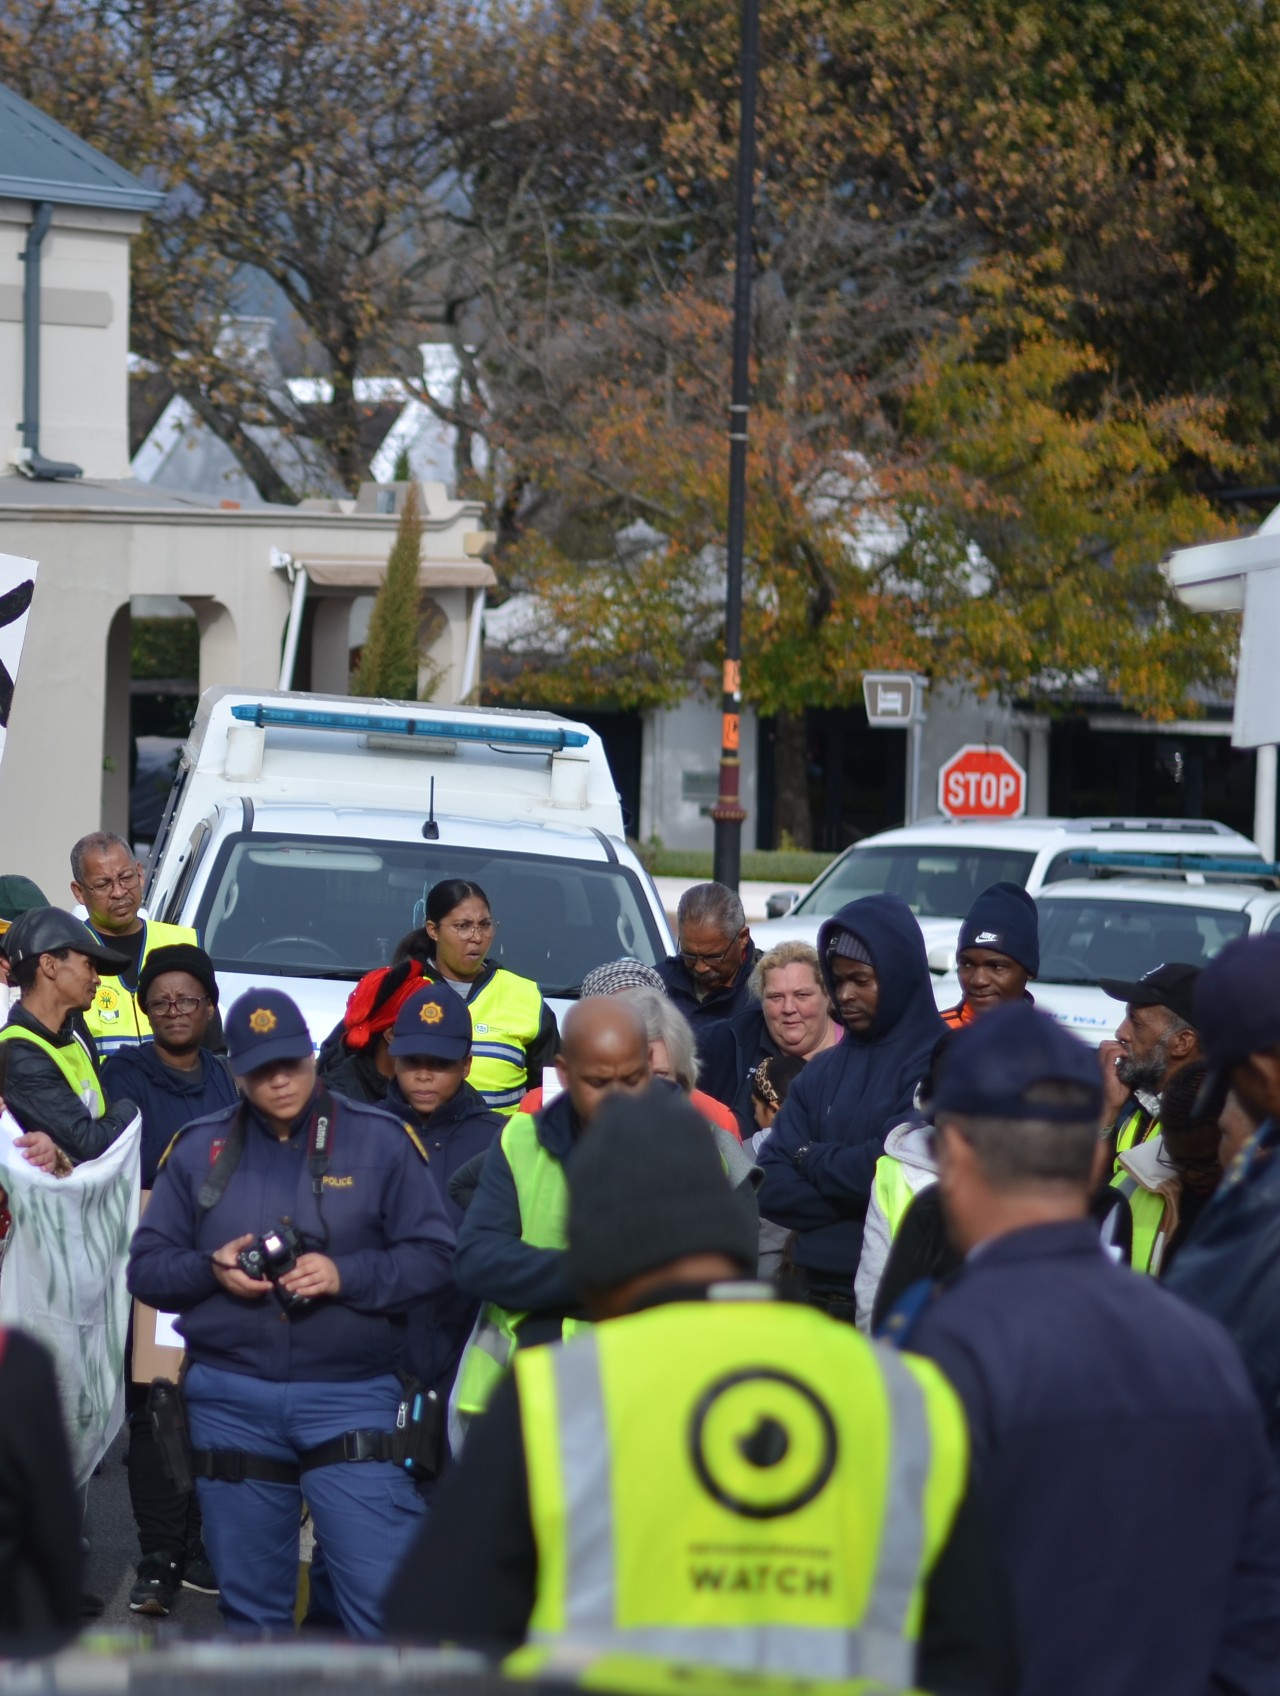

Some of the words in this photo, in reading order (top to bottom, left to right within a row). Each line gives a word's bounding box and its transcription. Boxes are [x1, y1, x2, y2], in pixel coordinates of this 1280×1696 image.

[948, 771, 1016, 809] STOP
[316, 1116, 328, 1149] Canon
[322, 1175, 353, 1187] POLICE
[688, 1564, 833, 1597] WATCH
